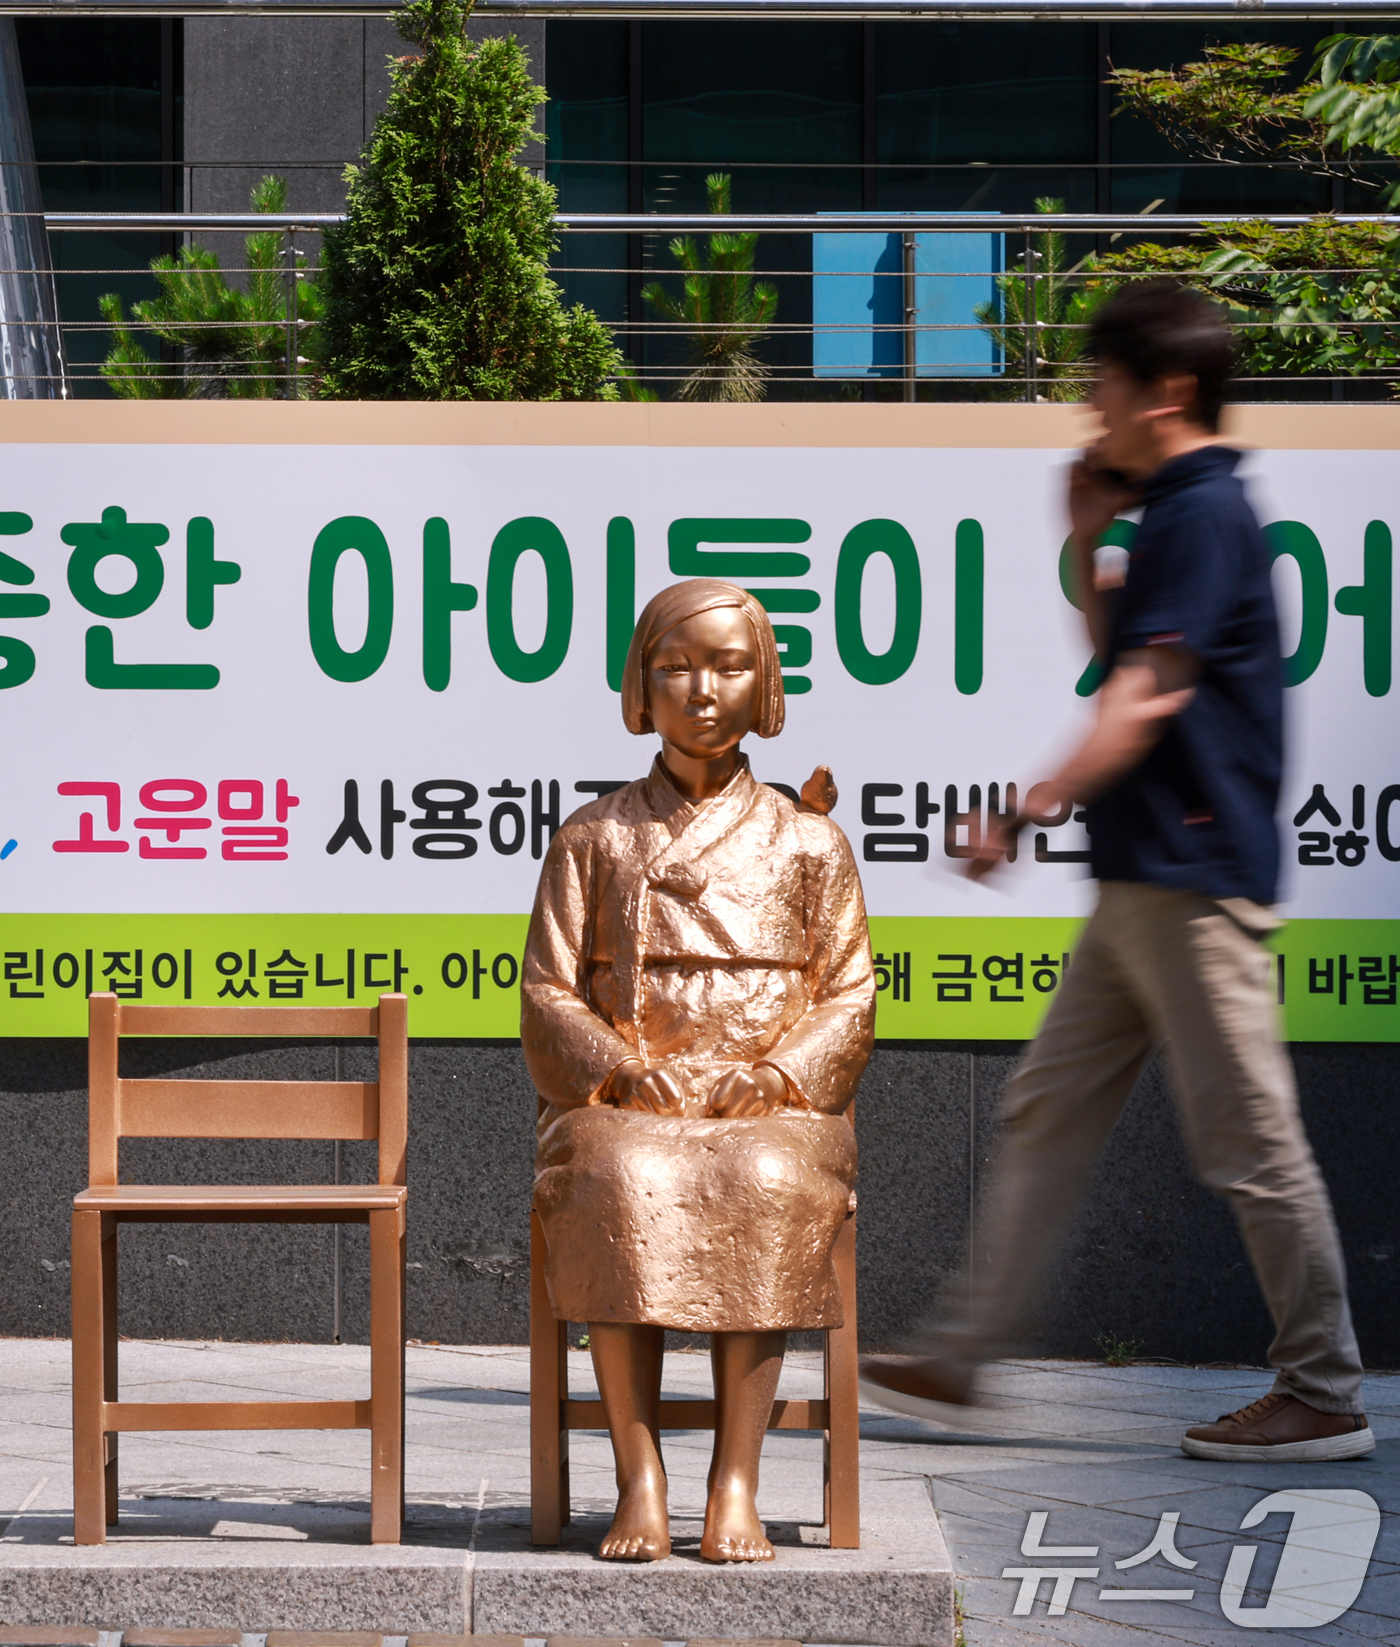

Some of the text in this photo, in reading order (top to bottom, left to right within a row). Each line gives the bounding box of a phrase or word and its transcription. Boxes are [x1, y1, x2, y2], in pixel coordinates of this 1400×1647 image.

[308, 515, 985, 695] 아이들이
[52, 778, 300, 860] 고운말
[215, 949, 423, 999] 있습니다.
